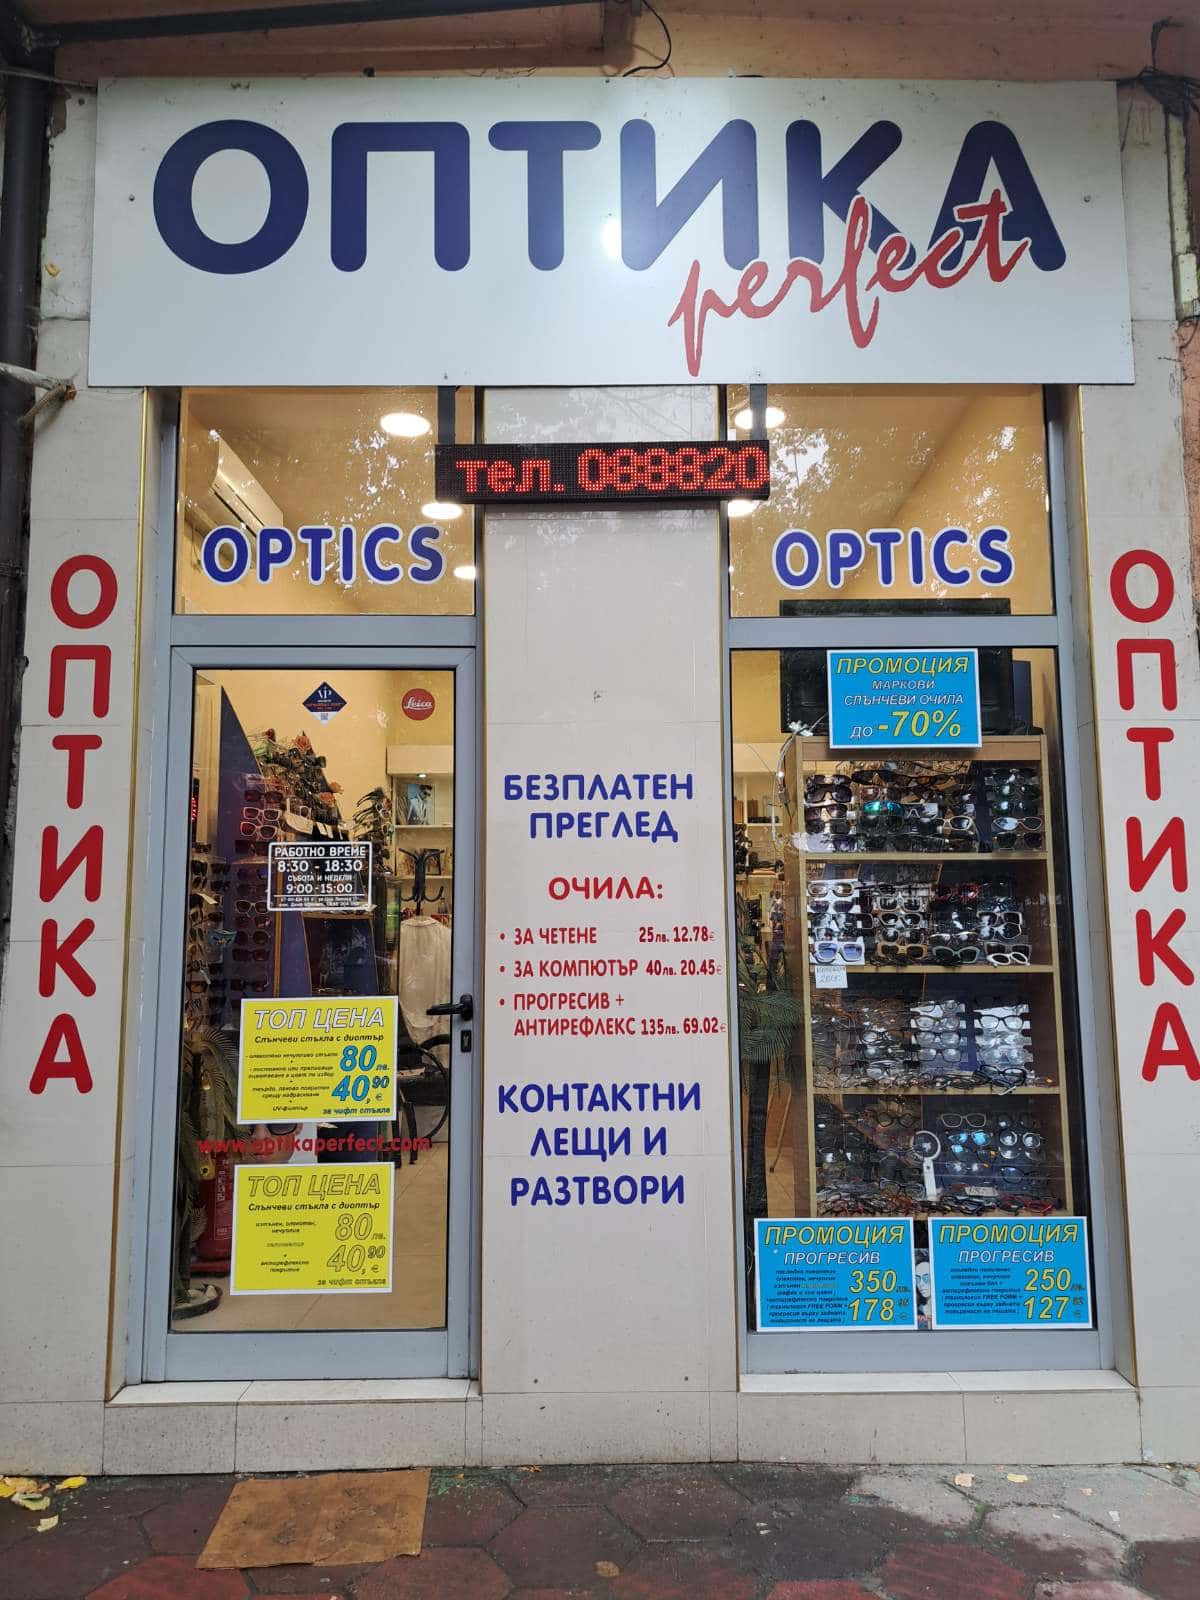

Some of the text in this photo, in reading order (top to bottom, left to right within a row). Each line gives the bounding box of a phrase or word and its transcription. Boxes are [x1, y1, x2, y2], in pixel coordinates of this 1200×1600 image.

[153, 119, 1066, 274] ОПТИКА
[668, 189, 1032, 376] perfect
[456, 447, 769, 492] тел. 088820
[203, 525, 445, 586] OPTICS
[774, 528, 1014, 589] OPTICS
[836, 656, 969, 677] ПРОМОЦИЯ
[872, 680, 935, 690] МАРКОВИ
[404, 697, 432, 710] Leica
[844, 694, 964, 706] СЛЪНЧЕВИ ОЧИЛА
[850, 710, 961, 739] ДО -70%
[504, 774, 693, 801] БЕЗПЛАТЕН
[29, 554, 118, 1094] ОПТИКА
[530, 811, 679, 843] ПРЕГЛЕД
[1110, 549, 1200, 1082] ОПТИКА
[274, 846, 367, 857] РАБОТНО ВРЕМЕ
[277, 860, 309, 872] 8:30
[325, 860, 363, 872] 18:30
[548, 876, 664, 901] ОЧИЛА:
[514, 928, 534, 945] ЗА
[539, 927, 598, 945] ЧЕТЕНЕ
[513, 960, 534, 977] ЗА
[539, 959, 638, 977] КОМПЮТЪР
[513, 993, 625, 1011] ПРОГРЕСИВ +
[254, 1007, 384, 1034] ТОП ЦЕНА
[514, 1016, 636, 1038] АНТИРЕФЛЕКС
[254, 1035, 299, 1044] Слънчеви
[343, 1034, 384, 1043] диоптър
[498, 1082, 701, 1114] КОНТАКТНИ
[197, 1132, 433, 1154] www.optikaperfect.com
[530, 1126, 667, 1163] ЛЕЩИ И
[248, 1175, 303, 1198] ТОП
[307, 1173, 381, 1201] ЦЕНА
[511, 1175, 685, 1207] РАЗТВОРИ
[248, 1203, 292, 1211] Слънчеви
[338, 1202, 380, 1210] диоптър
[764, 1225, 905, 1249] ПРОМОЦИЯ
[938, 1223, 1079, 1247] ПРОМОЦИЯ
[784, 1251, 881, 1265] ПРОГРЕСИВ
[958, 1249, 1055, 1263] ПРОГРЕСИВ
[849, 1269, 898, 1294] 350
[1024, 1267, 1072, 1292] 250
